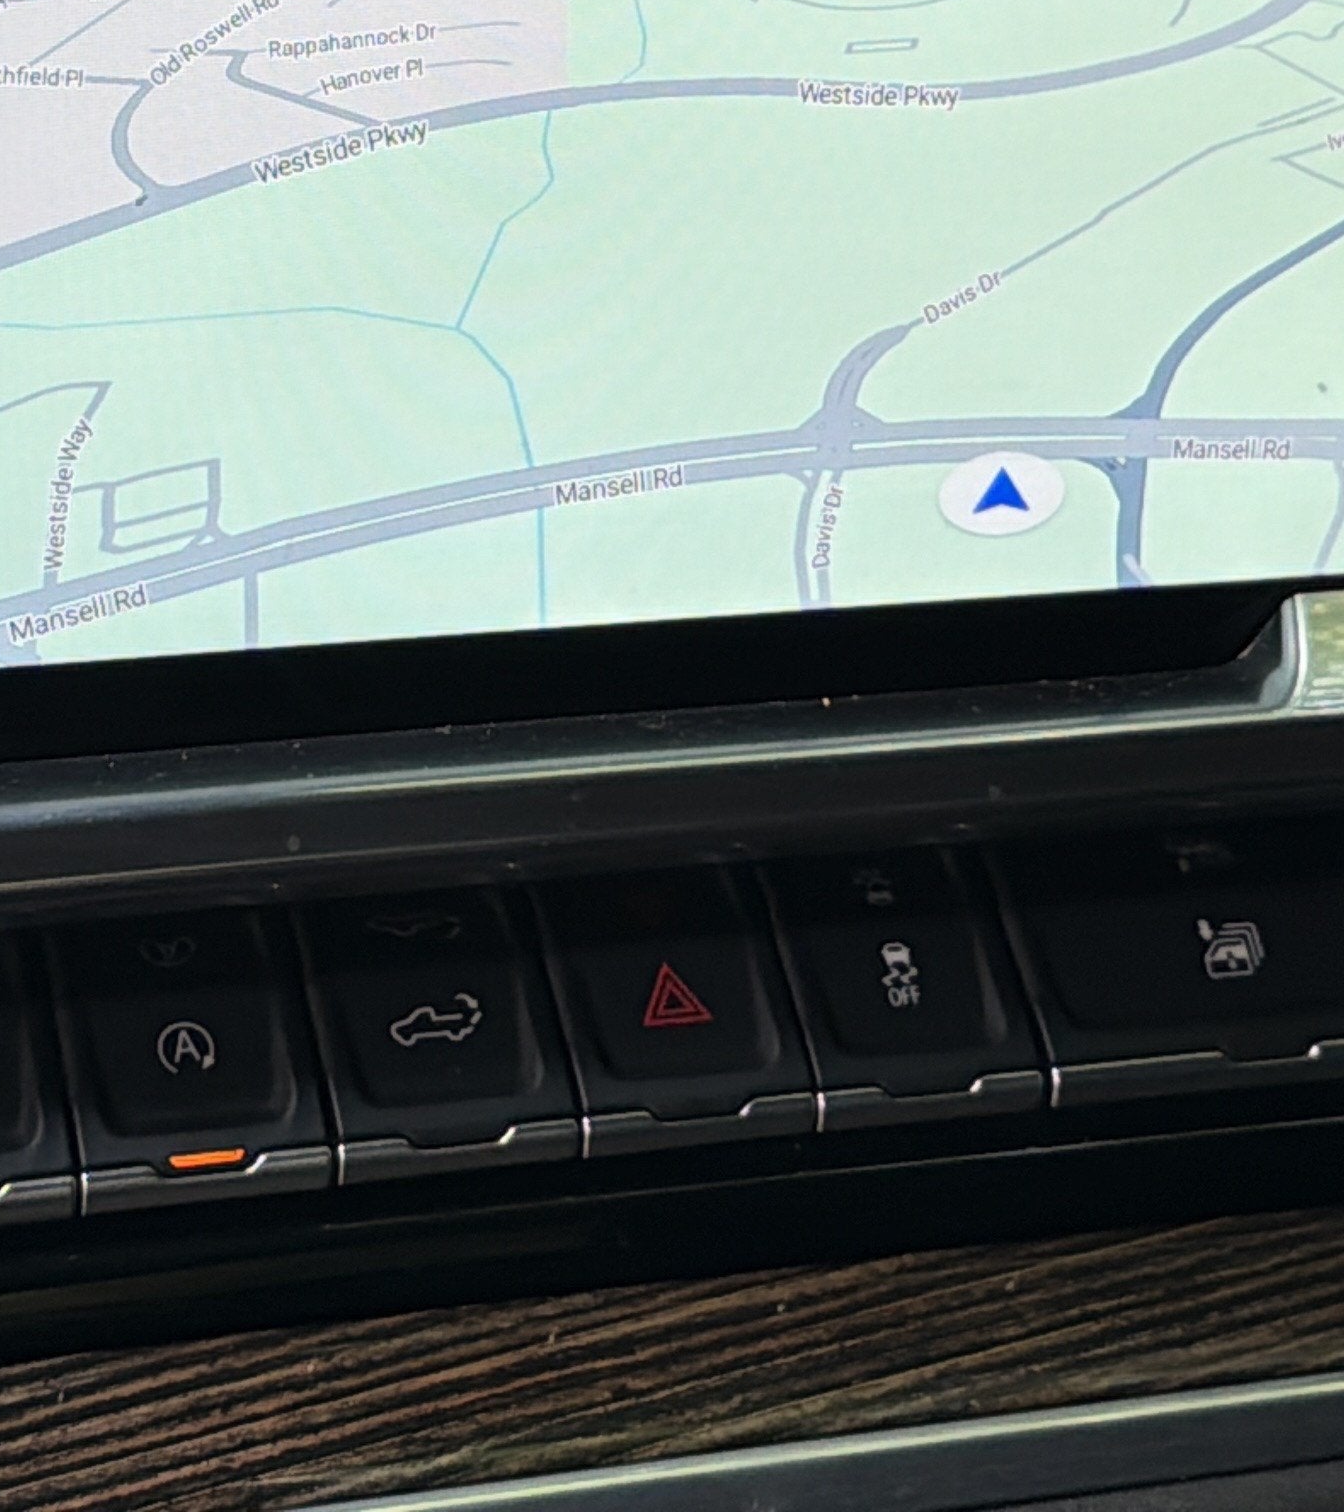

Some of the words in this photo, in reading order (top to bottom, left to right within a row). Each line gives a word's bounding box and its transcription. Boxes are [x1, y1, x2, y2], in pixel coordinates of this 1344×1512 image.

[149, 53, 183, 88] Old
[178, 10, 254, 63] Roswell
[268, 28, 411, 61] Rappahannock
[415, 23, 437, 42] Dr
[64, 68, 85, 88] Pl
[319, 64, 402, 96] Hanover
[405, 57, 424, 78] Pl
[799, 81, 898, 108] Westside
[903, 84, 959, 110] Pkwy
[253, 134, 363, 183] Westside
[366, 119, 429, 155] Pkwy
[922, 283, 977, 325] Davis
[977, 269, 1002, 294] Dr
[58, 418, 93, 464] Way
[1172, 438, 1255, 461] Mansell
[1260, 437, 1291, 460] Rd
[554, 471, 646, 507] Mansell
[649, 464, 684, 492] Rd
[821, 485, 843, 510] Dr
[43, 460, 76, 569] Westside
[812, 510, 840, 569] Davis
[8, 596, 105, 645] Mansell
[107, 583, 147, 619] Rd
[887, 984, 922, 1008] OFF
